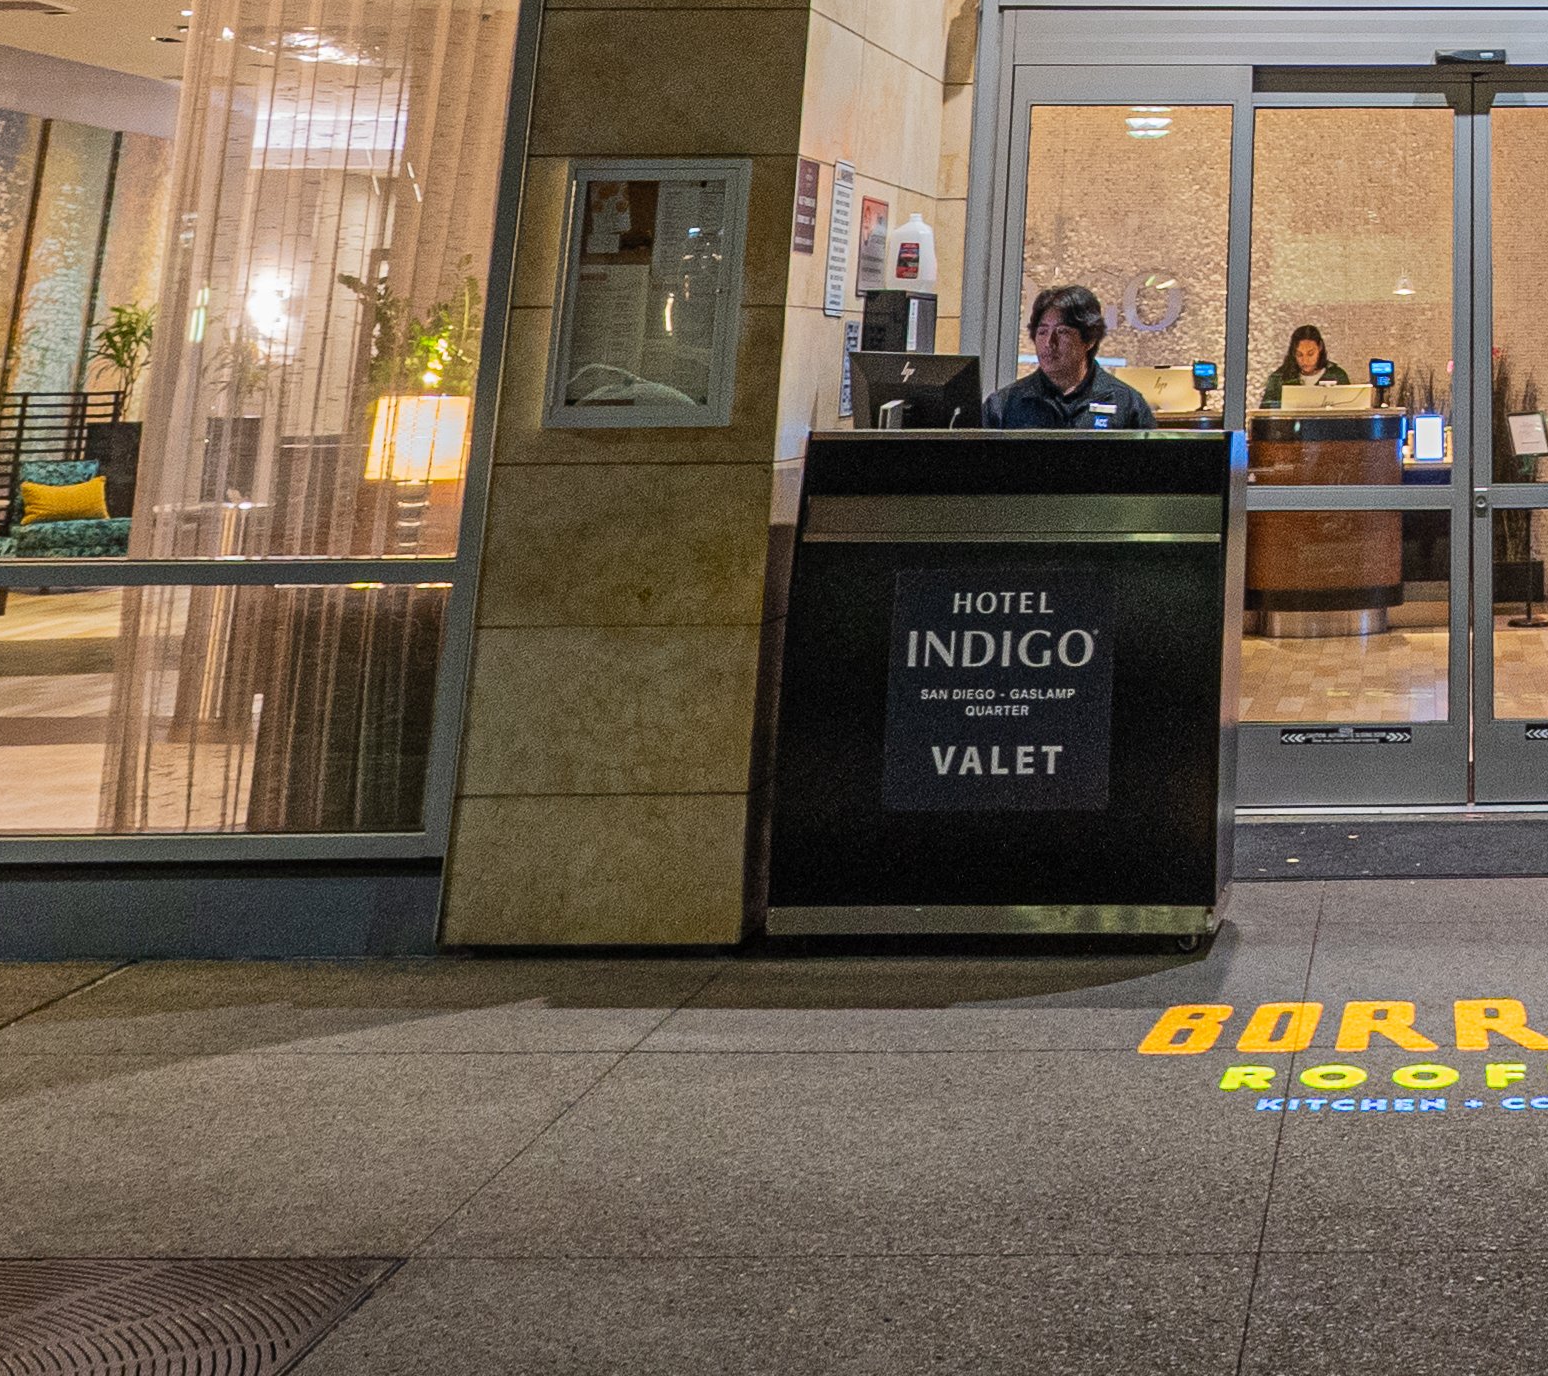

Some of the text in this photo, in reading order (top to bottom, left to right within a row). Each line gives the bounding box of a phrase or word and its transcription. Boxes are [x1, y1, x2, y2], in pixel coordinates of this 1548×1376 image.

[952, 591, 1054, 614] HOTEL
[907, 629, 1095, 668] INDIGO
[920, 688, 949, 700] SAN
[952, 688, 995, 700] DIEGO
[1010, 688, 1076, 699] GASLAMP
[965, 705, 1030, 717] QUARTER
[931, 744, 1064, 776] VALET
[1255, 1096, 1447, 1113] KITCHEN
